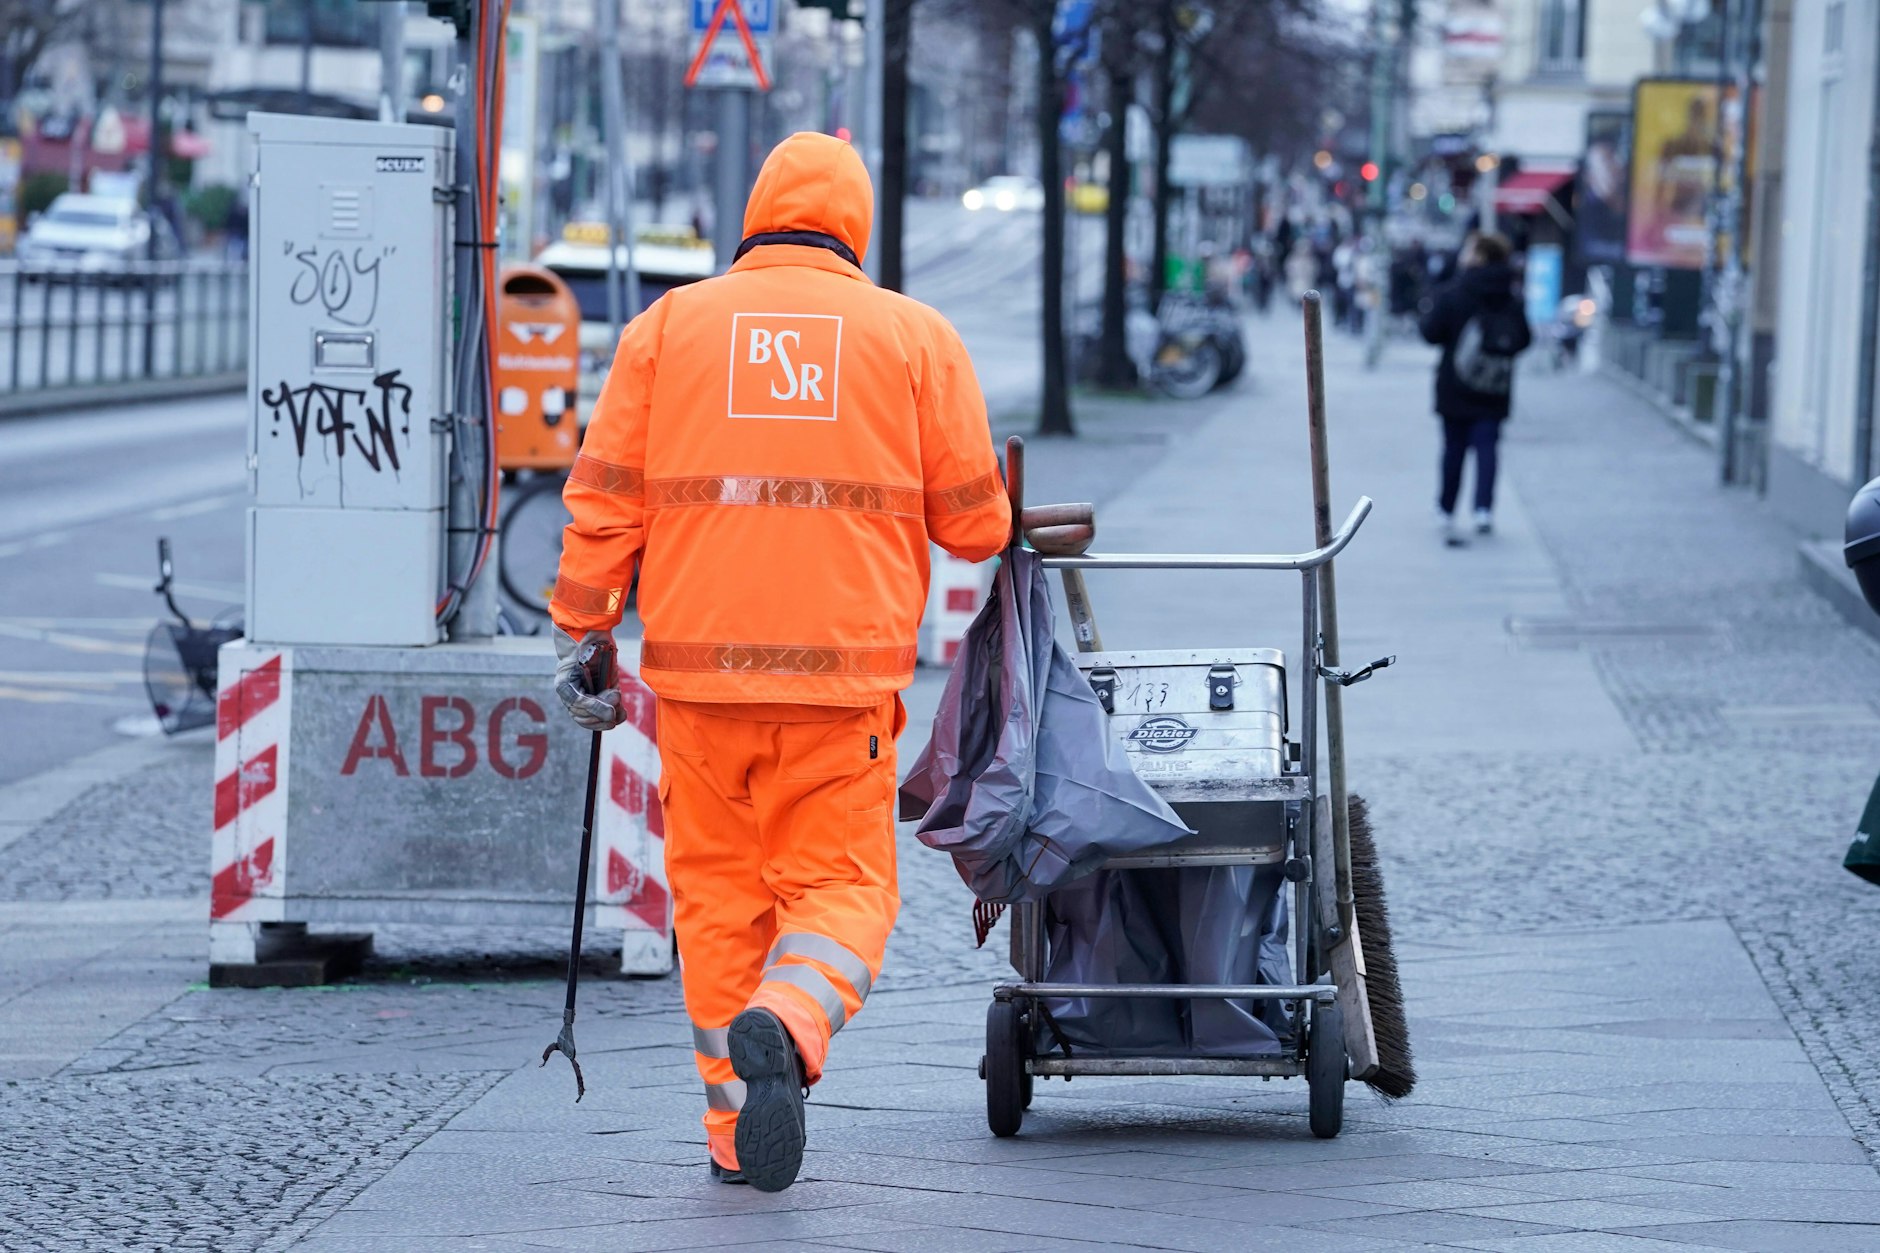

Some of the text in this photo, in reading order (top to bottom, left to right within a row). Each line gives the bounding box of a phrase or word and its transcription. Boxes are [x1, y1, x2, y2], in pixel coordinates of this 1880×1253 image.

[748, 328, 824, 401] BSR
[340, 695, 548, 780] ABG
[1134, 727, 1193, 739] Dickies
